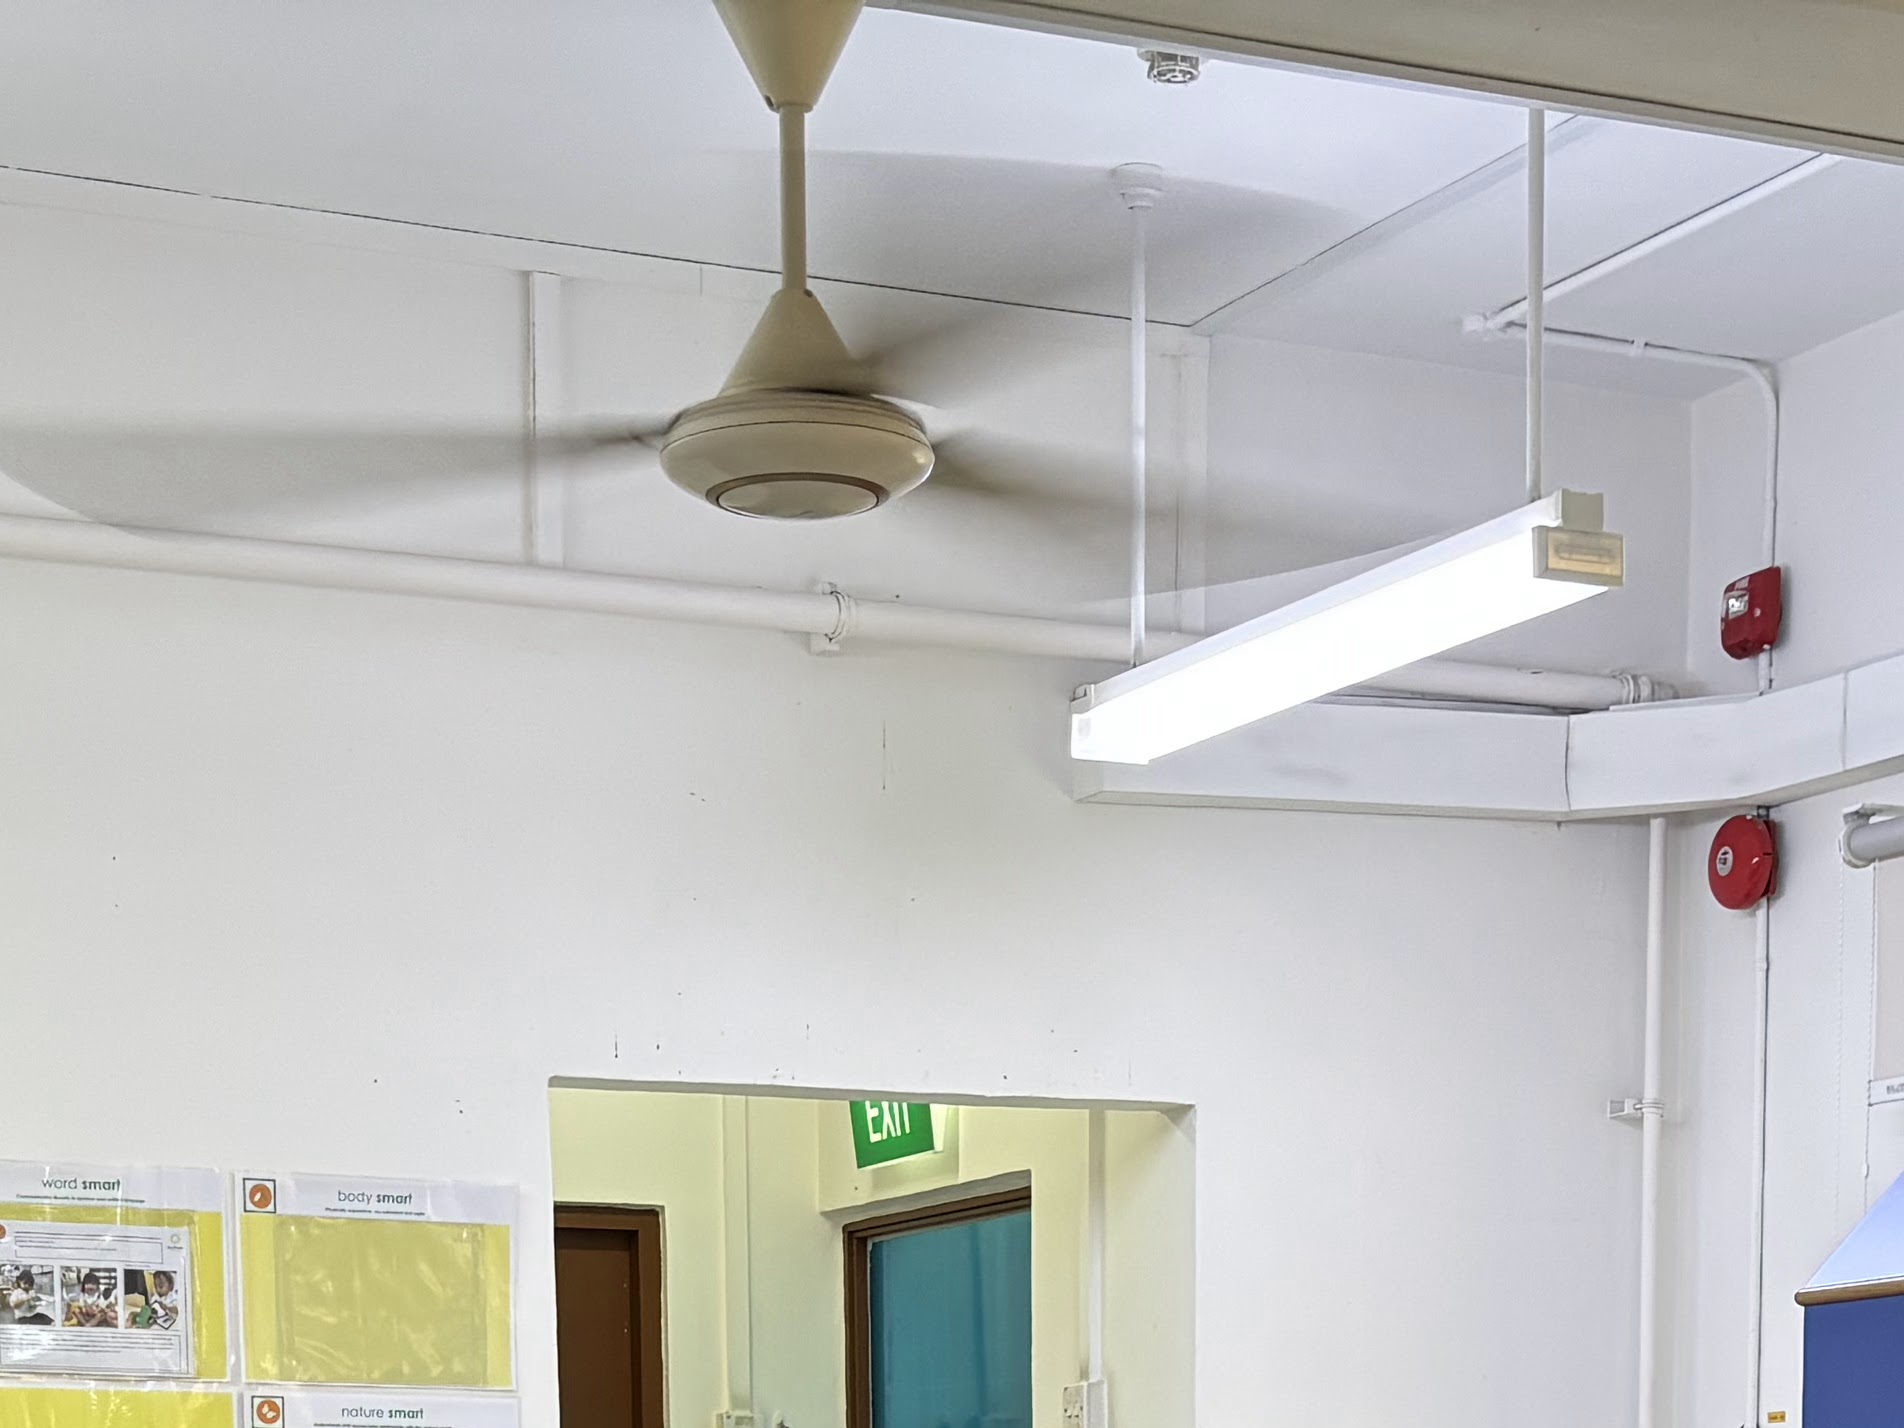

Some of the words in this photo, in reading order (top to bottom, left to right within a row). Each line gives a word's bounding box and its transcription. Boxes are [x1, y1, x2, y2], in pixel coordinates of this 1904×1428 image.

[42, 1177, 78, 1190] word
[81, 1178, 121, 1192] smart
[338, 1190, 372, 1206] body
[376, 1192, 413, 1205] smart
[341, 1406, 384, 1419] nature
[388, 1407, 424, 1420] smart
